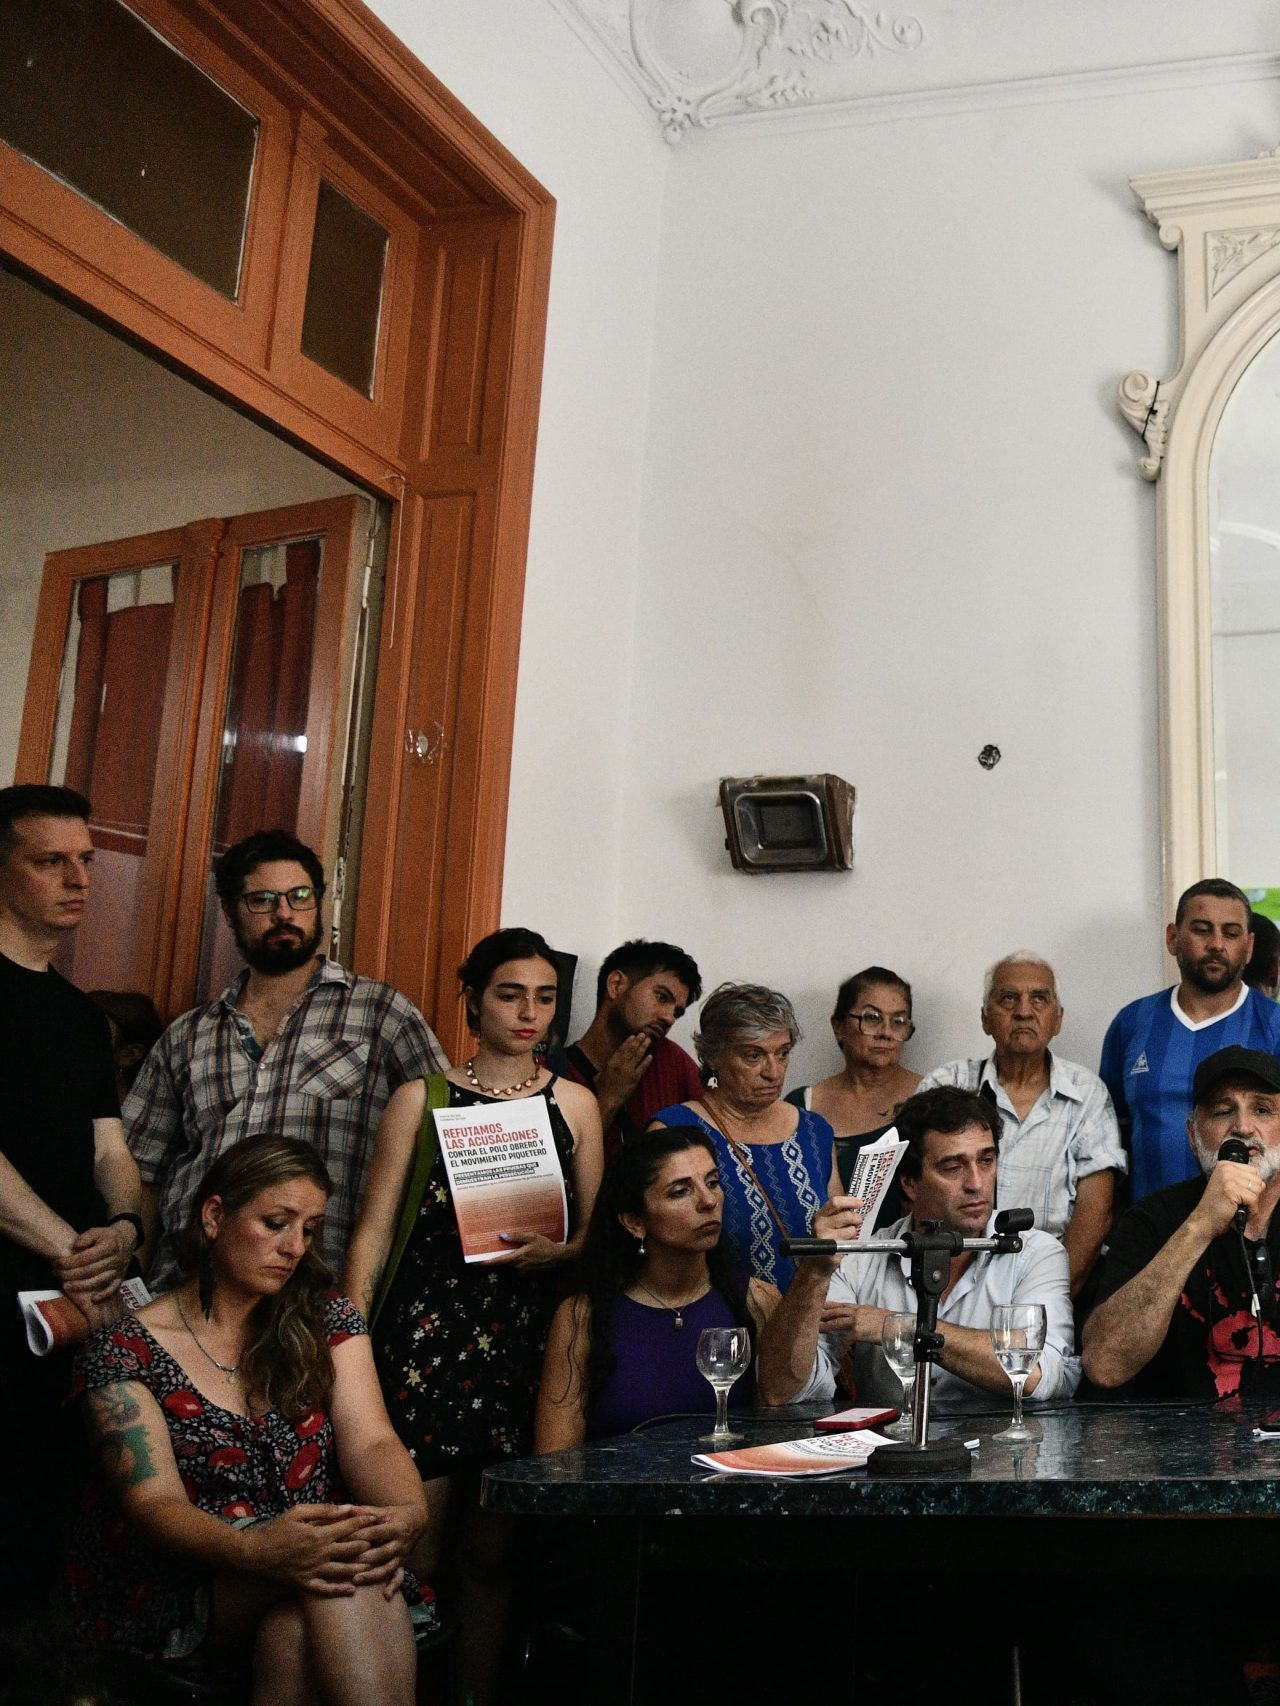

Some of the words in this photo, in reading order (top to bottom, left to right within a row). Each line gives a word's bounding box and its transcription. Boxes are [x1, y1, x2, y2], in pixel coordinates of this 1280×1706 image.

[442, 1122, 503, 1139] REFUTAMOS
[445, 1138, 465, 1150] LAS
[468, 1128, 539, 1148] ACUSACIONES
[448, 1148, 478, 1159] CONTRA
[479, 1147, 489, 1155] EL
[489, 1144, 508, 1154] POLO
[510, 1140, 538, 1152] OBRERO
[539, 1139, 544, 1147] Y
[450, 1160, 458, 1168] EL
[461, 1153, 507, 1166] MOVIMIENTO
[508, 1147, 547, 1160] PIQUETERO
